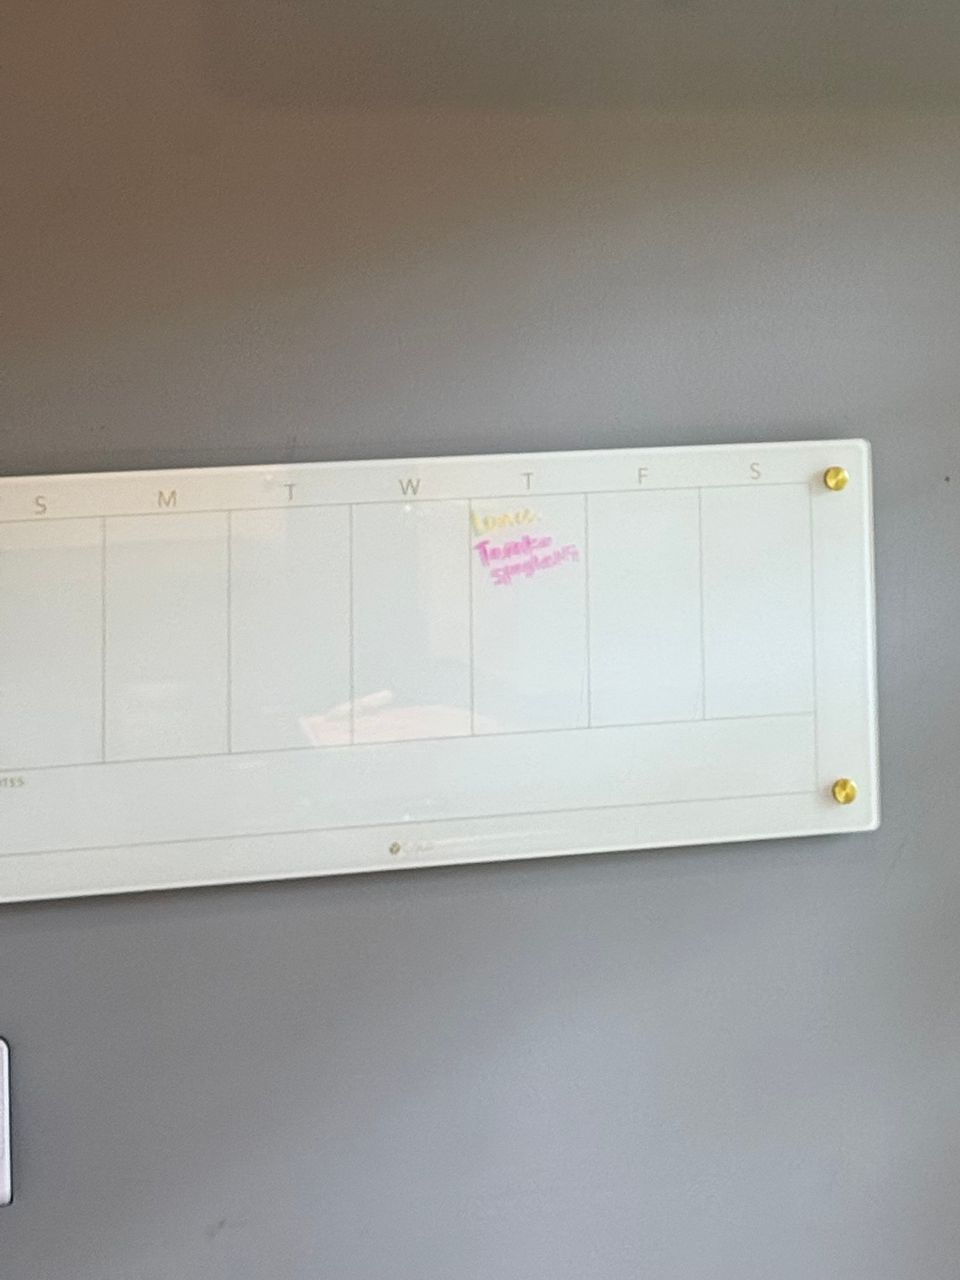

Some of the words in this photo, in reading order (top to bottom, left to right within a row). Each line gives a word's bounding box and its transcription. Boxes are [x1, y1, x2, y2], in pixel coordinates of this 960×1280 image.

[34, 495, 48, 515] S
[157, 489, 178, 508] M
[283, 483, 297, 501] T
[399, 478, 421, 496] W
[522, 472, 534, 490] T
[638, 467, 649, 485] F
[750, 462, 762, 480] S
